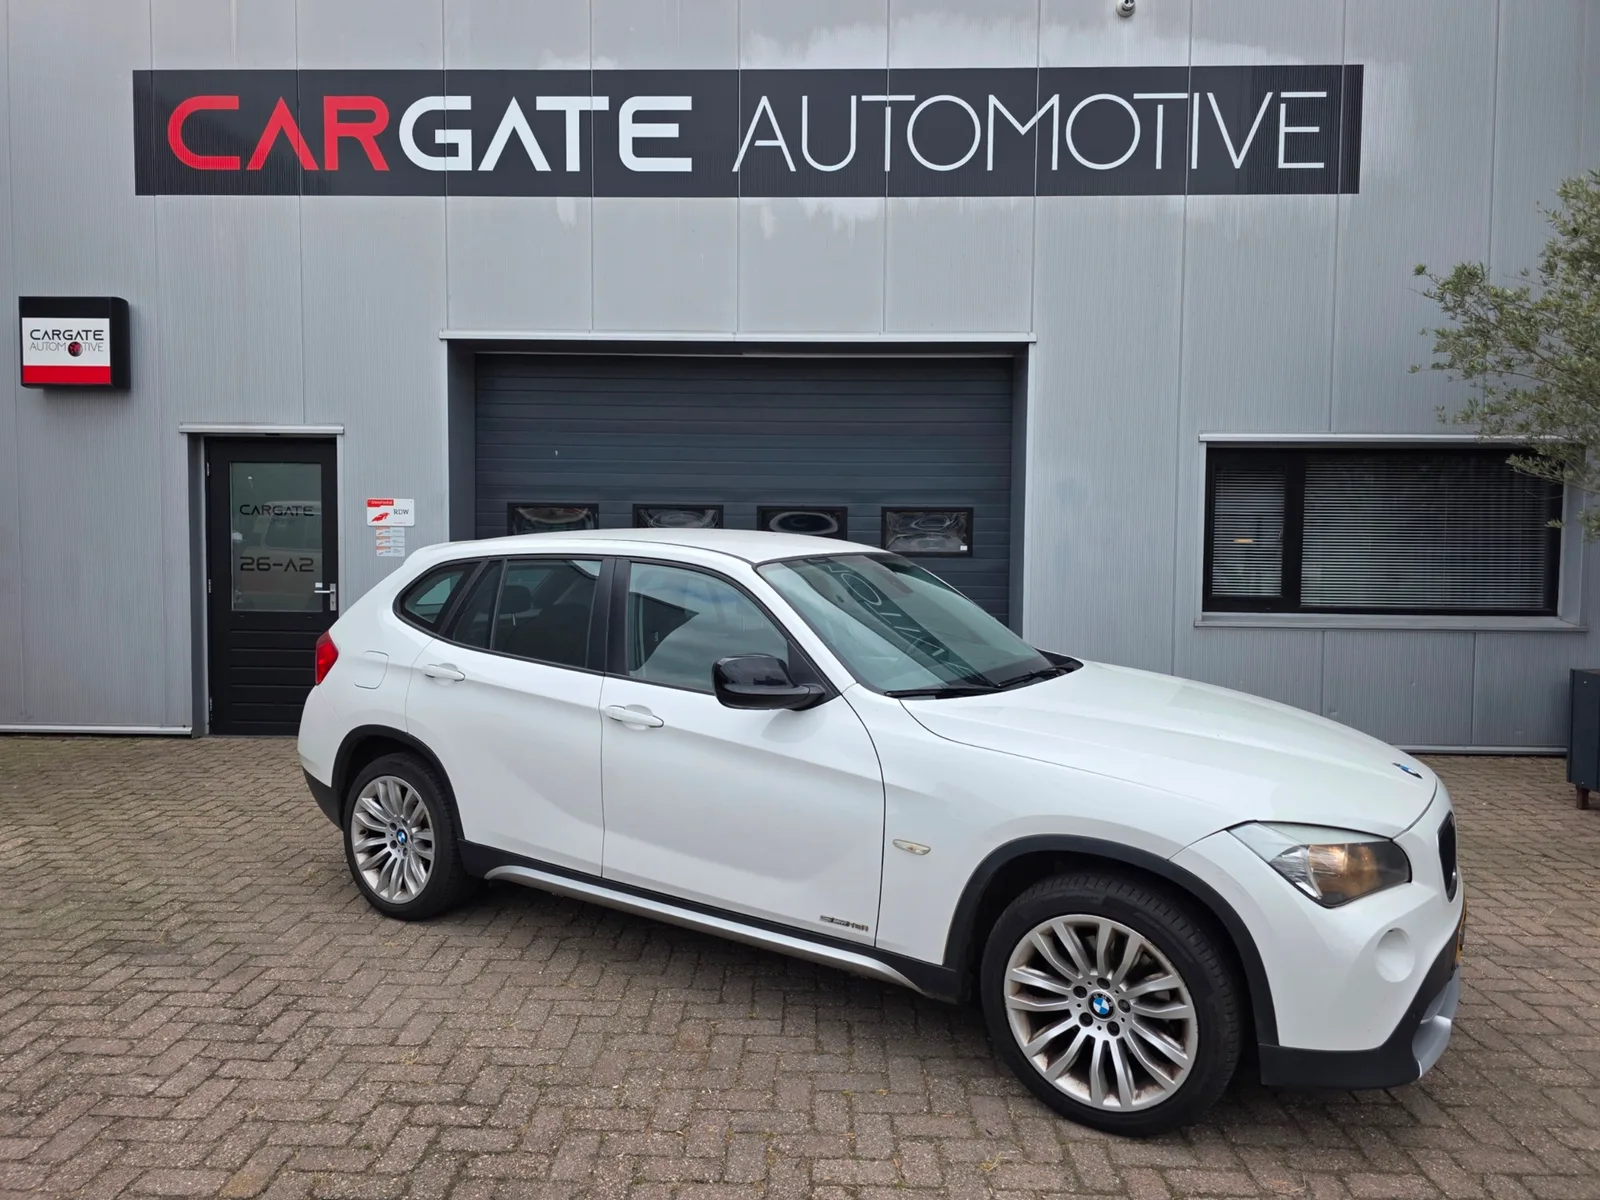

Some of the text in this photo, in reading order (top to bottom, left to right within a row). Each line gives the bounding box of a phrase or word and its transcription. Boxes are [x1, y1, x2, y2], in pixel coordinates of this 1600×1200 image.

[167, 90, 1328, 172] CARGATE AUTOMOTIVE
[30, 329, 104, 340] CARGATE
[240, 504, 314, 516] CARGATE
[240, 556, 314, 572] 26-A2
